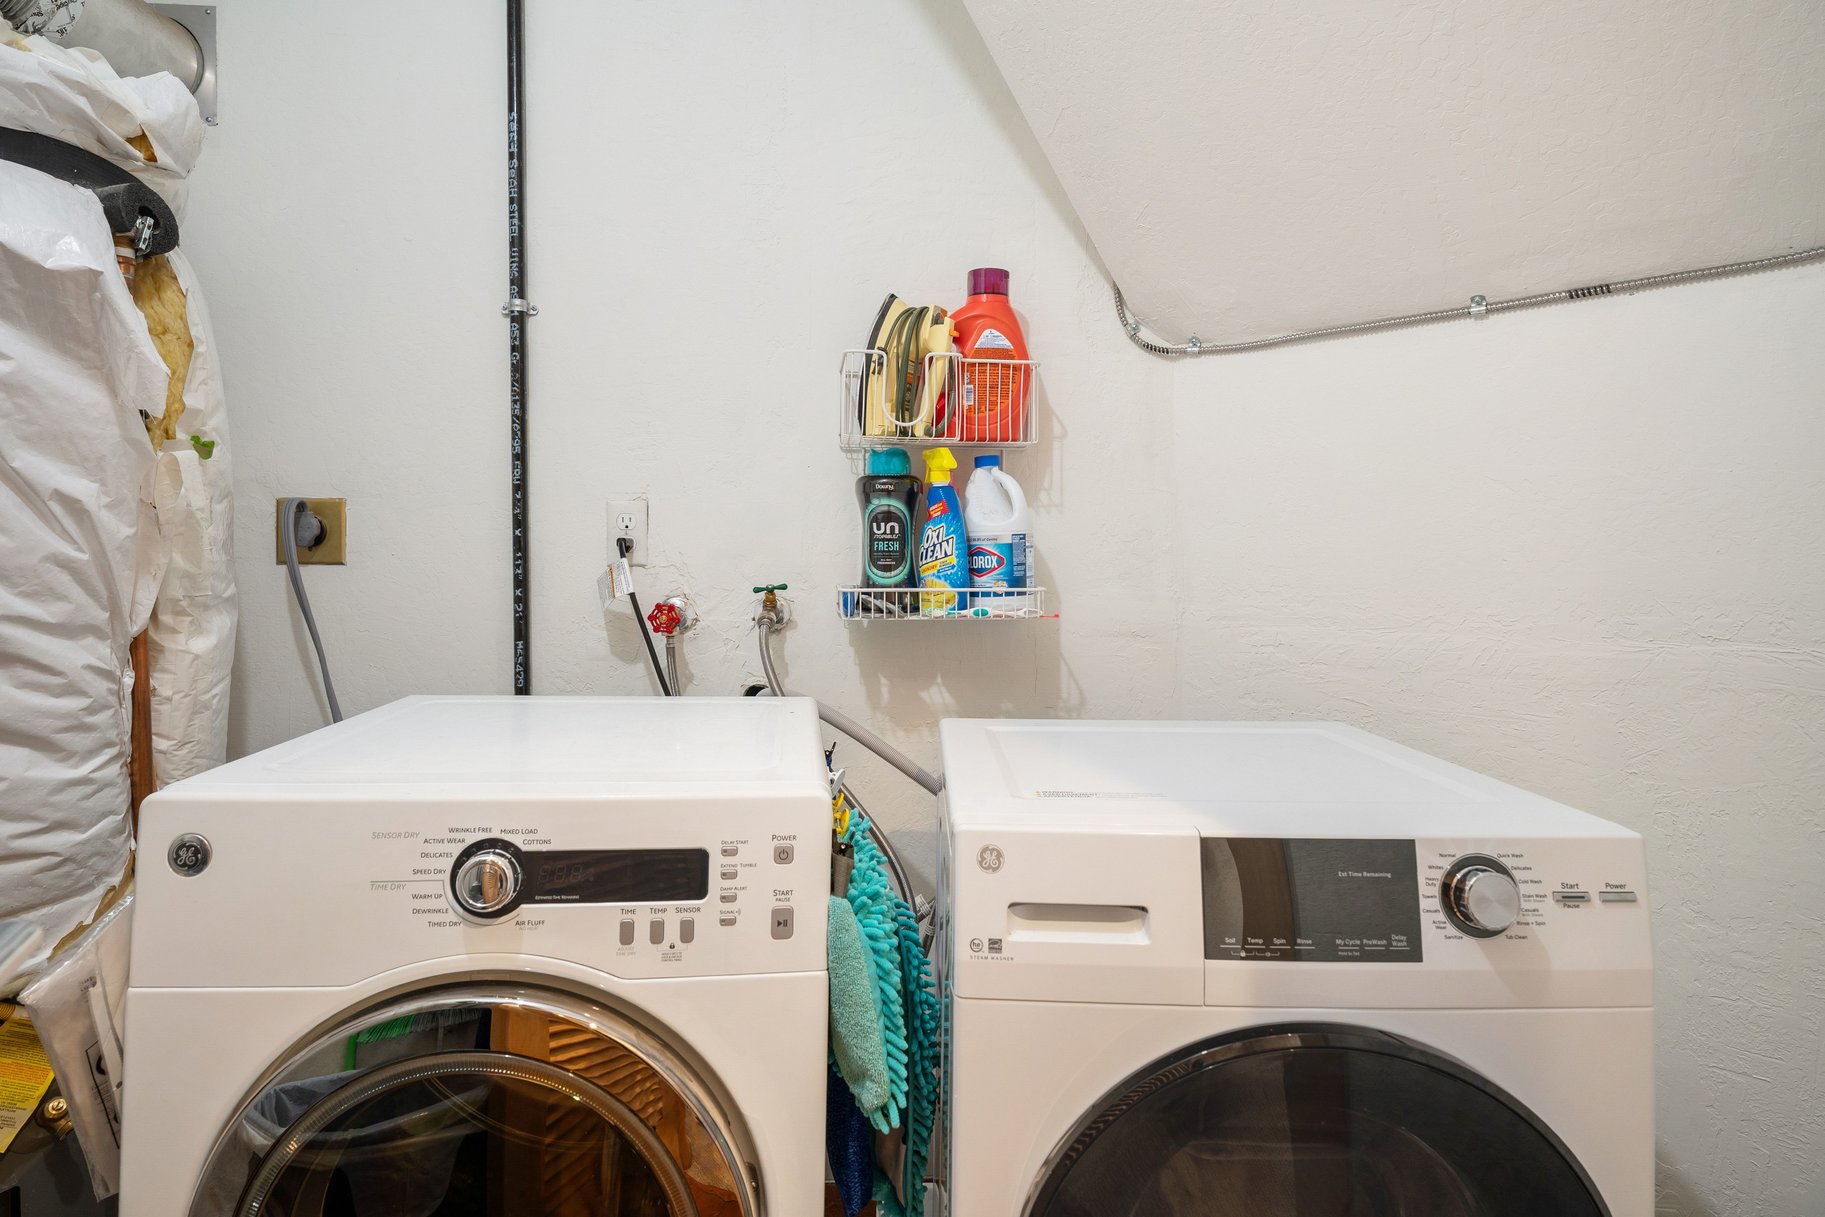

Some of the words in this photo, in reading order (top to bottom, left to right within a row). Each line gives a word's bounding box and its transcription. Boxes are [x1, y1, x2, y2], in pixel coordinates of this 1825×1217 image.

[509, 203, 519, 242] STEEL
[874, 541, 899, 551] FRESH
[924, 526, 944, 548] OXI
[920, 537, 954, 565] CLEAN
